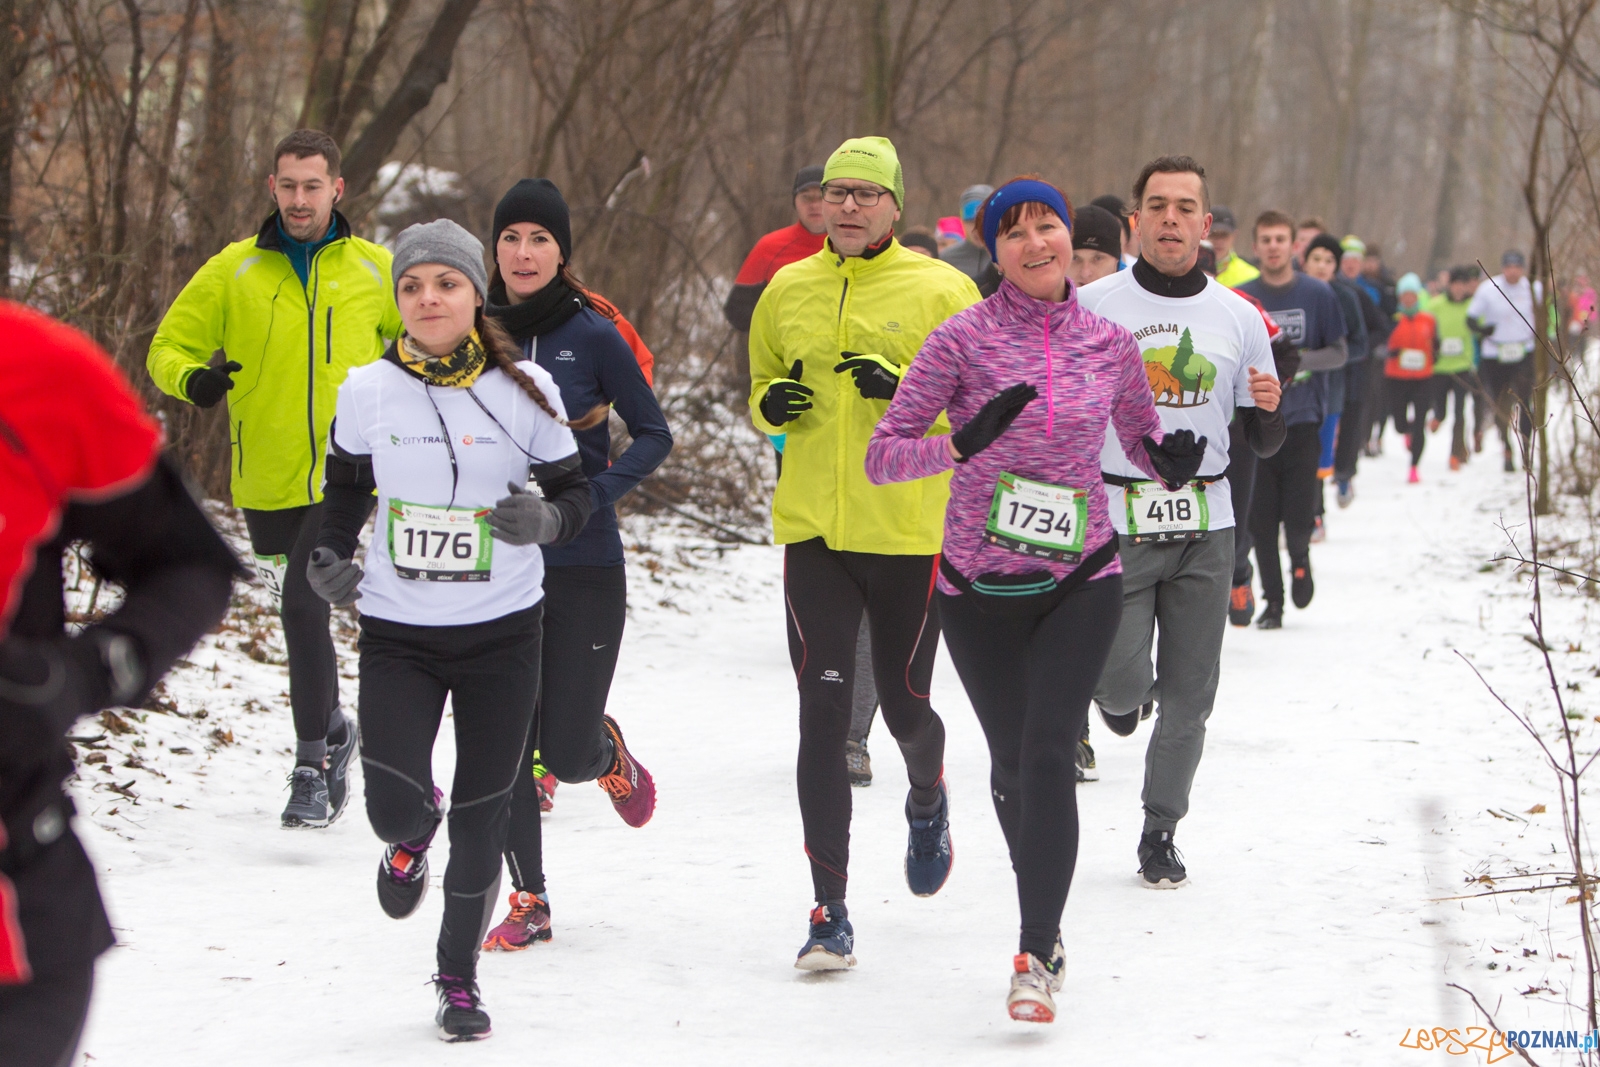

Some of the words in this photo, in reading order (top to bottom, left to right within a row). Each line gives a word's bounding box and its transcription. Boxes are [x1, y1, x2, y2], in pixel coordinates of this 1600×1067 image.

[1133, 323, 1179, 341] BIEGAJĄ
[1009, 501, 1071, 538] 1734
[1146, 498, 1191, 522] 418
[1158, 523, 1184, 531] PRZEMO
[403, 527, 472, 559] 1176
[426, 561, 446, 569] ZBUJ
